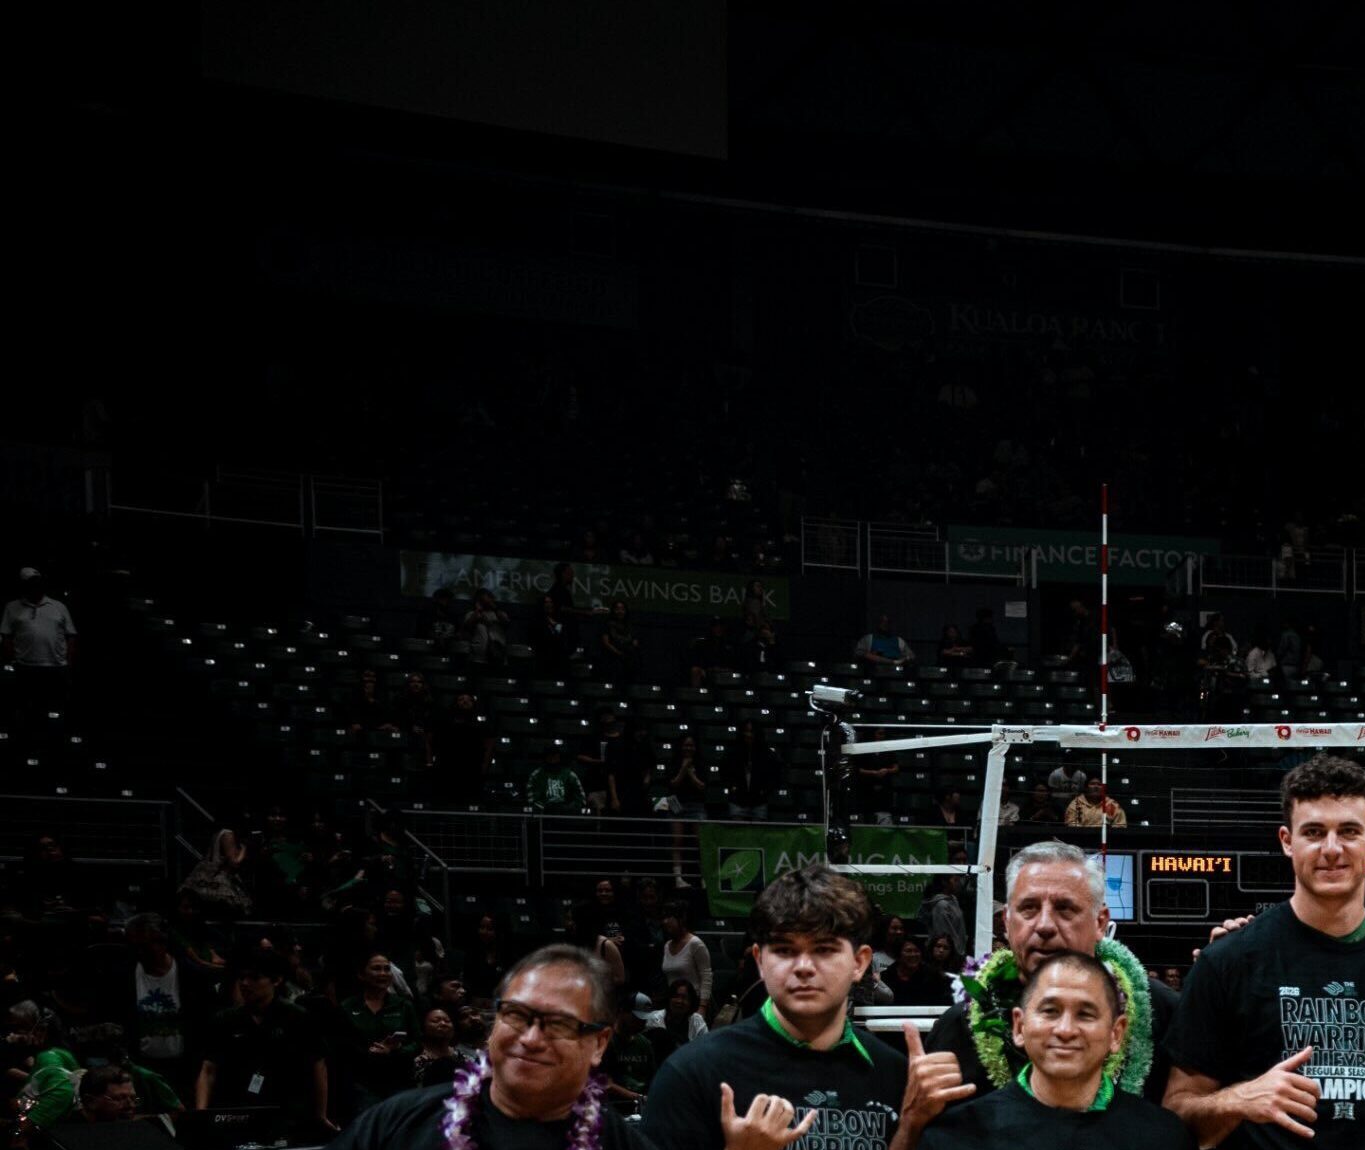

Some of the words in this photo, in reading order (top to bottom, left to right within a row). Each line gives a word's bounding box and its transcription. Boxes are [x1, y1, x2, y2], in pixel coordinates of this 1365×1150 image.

[455, 566, 591, 596] AMERICN
[599, 577, 703, 603] SAVINGS
[710, 584, 776, 610] BAK
[1307, 1067, 1342, 1076] REGULAR
